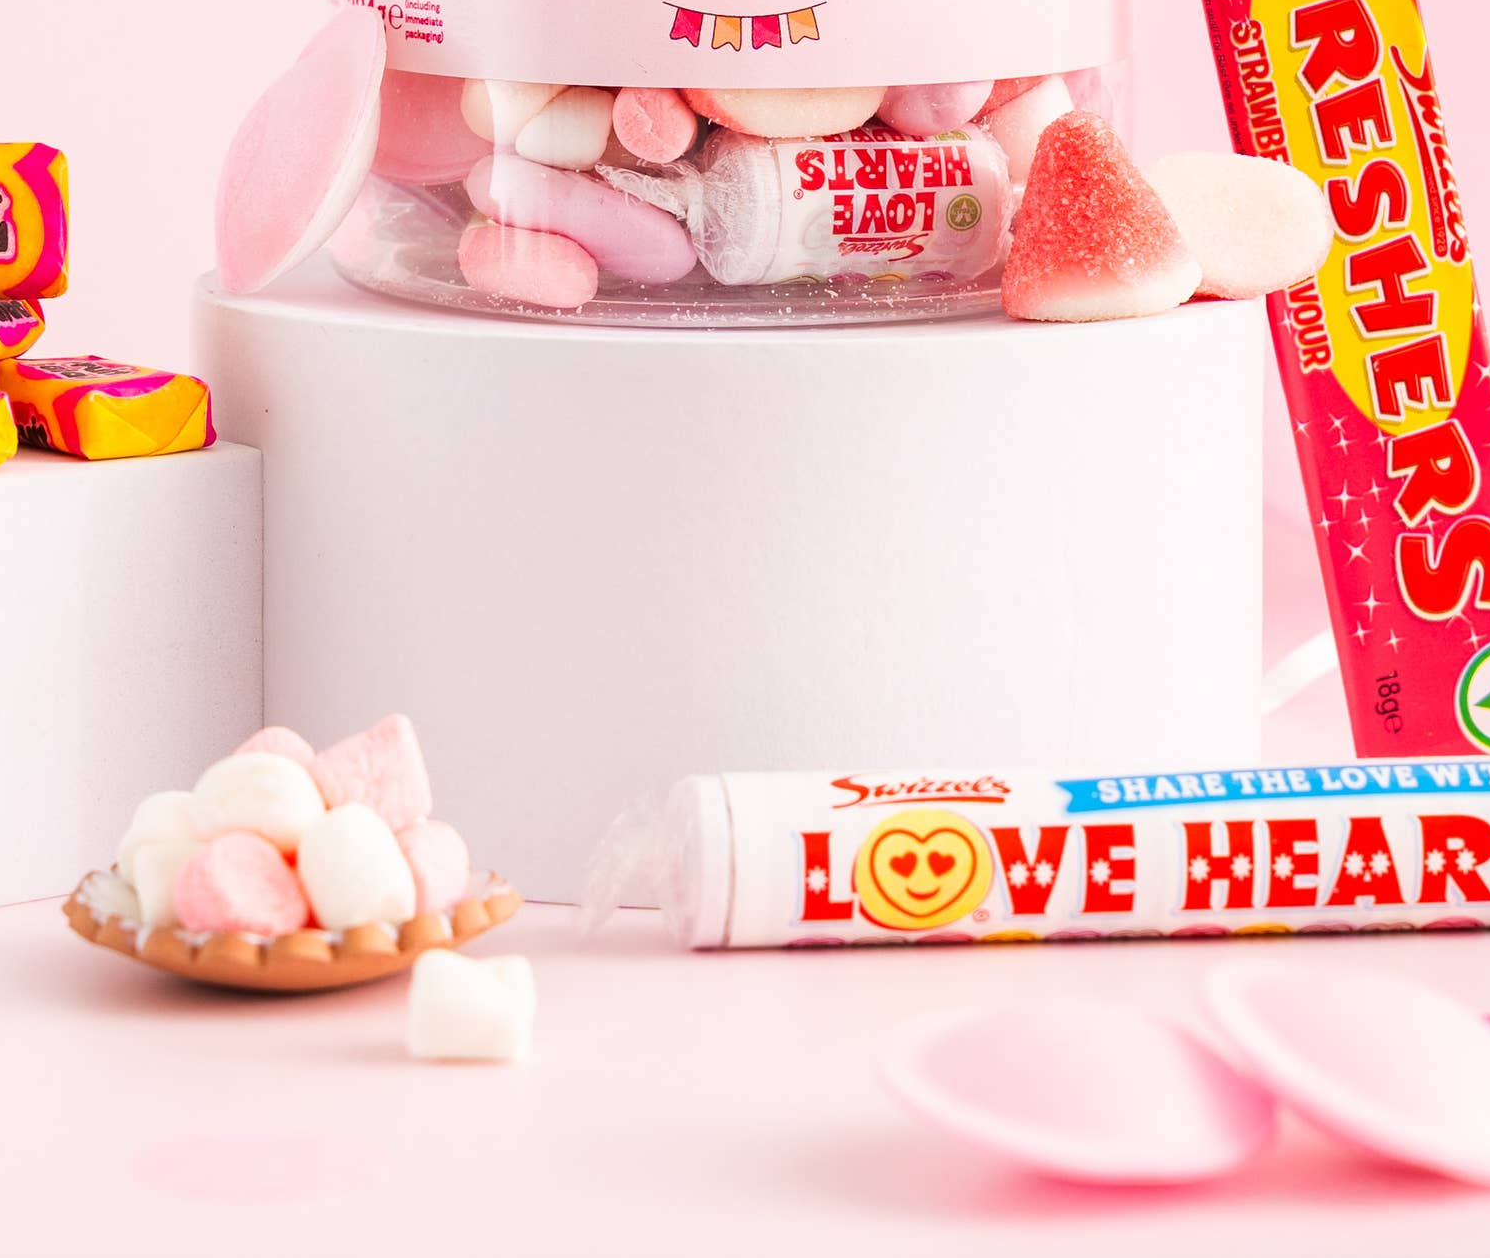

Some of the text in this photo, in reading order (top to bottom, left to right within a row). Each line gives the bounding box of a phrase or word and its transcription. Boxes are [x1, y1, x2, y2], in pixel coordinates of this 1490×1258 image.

[795, 146, 973, 191] HEARTS
[832, 192, 936, 235] LOVE
[1436, 223, 1447, 253] 1928
[1287, 275, 1333, 372] VOUR
[1098, 773, 1226, 804] SHARE
[1234, 769, 1310, 796] THE
[1315, 764, 1417, 792] LOVE
